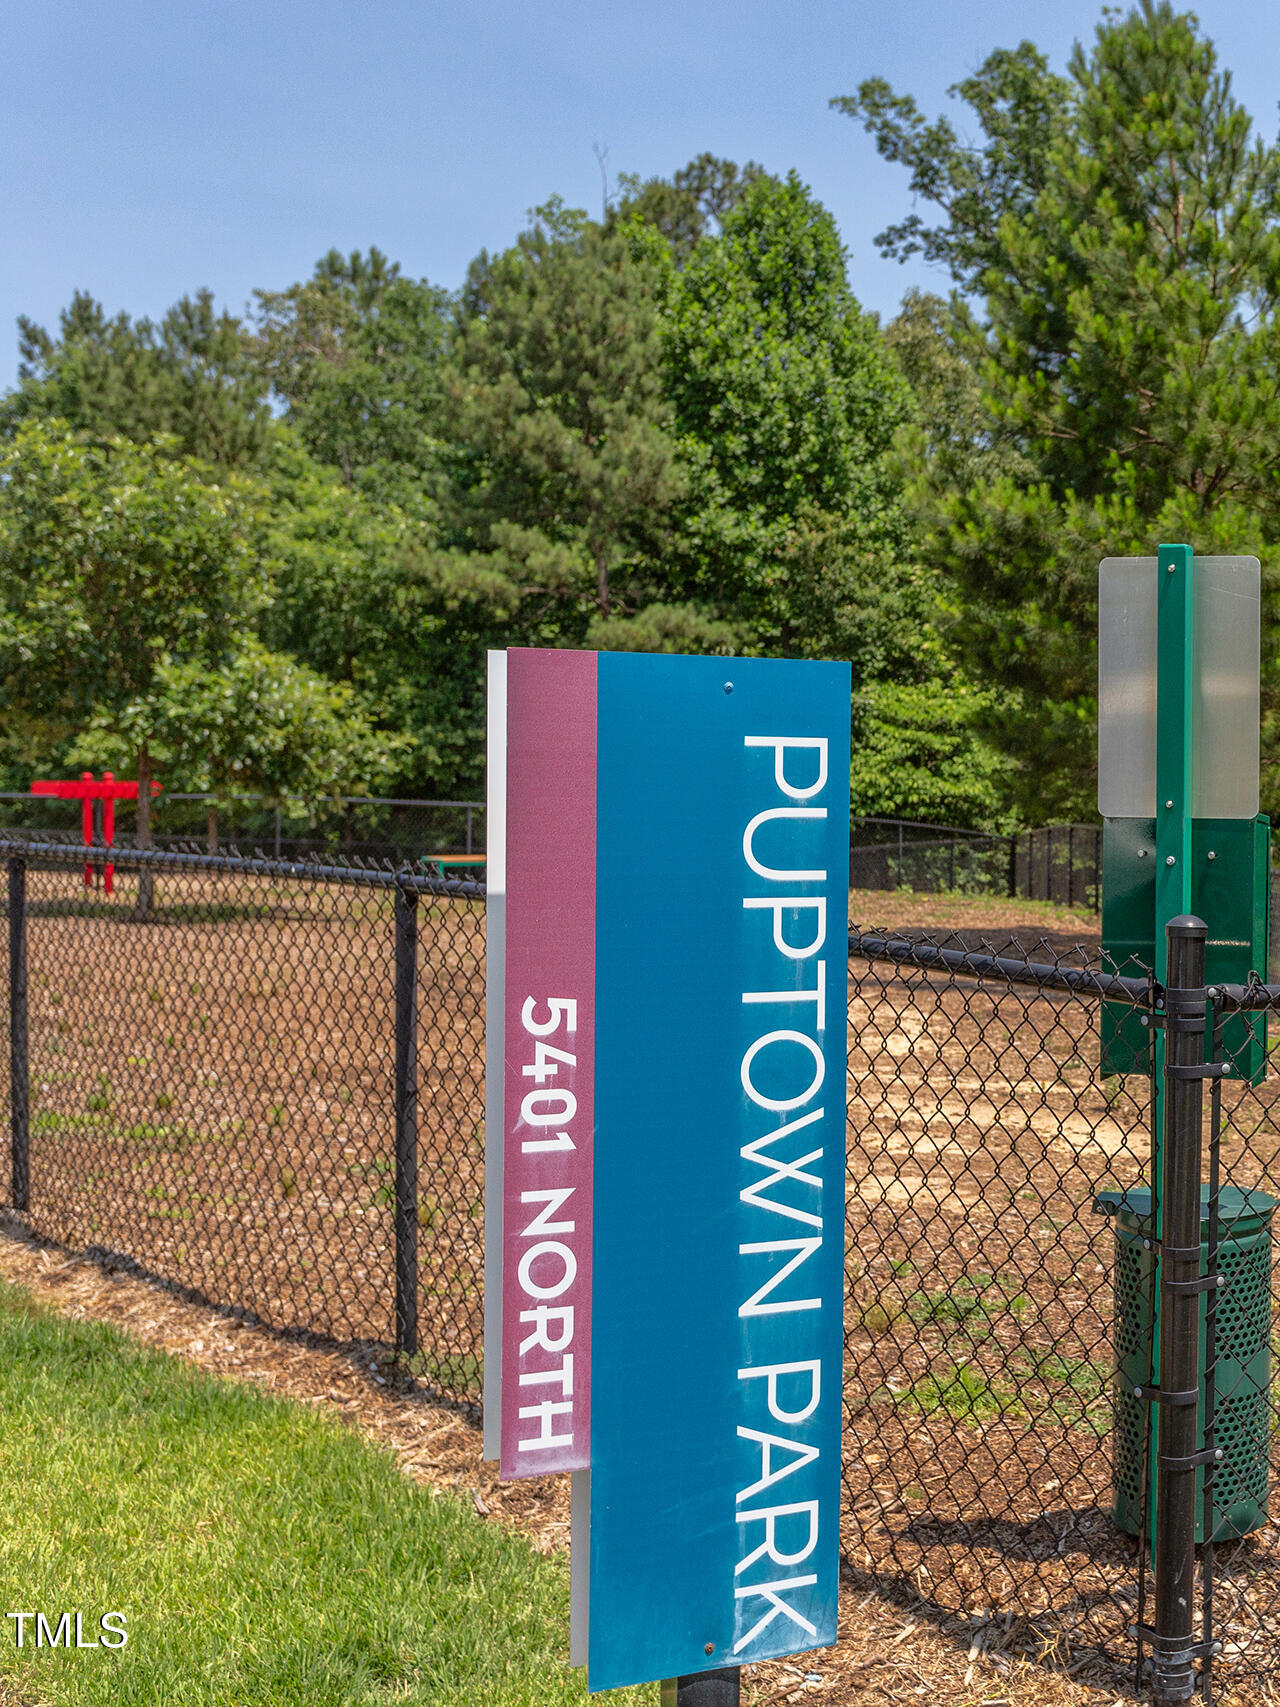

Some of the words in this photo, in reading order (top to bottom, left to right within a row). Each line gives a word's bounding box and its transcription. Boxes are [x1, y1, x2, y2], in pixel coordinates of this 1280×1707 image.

[520, 995, 578, 1155] 5401
[739, 735, 829, 1318] PUPTOWN
[517, 1187, 578, 1453] NORTH
[733, 1359, 821, 1655] PARK
